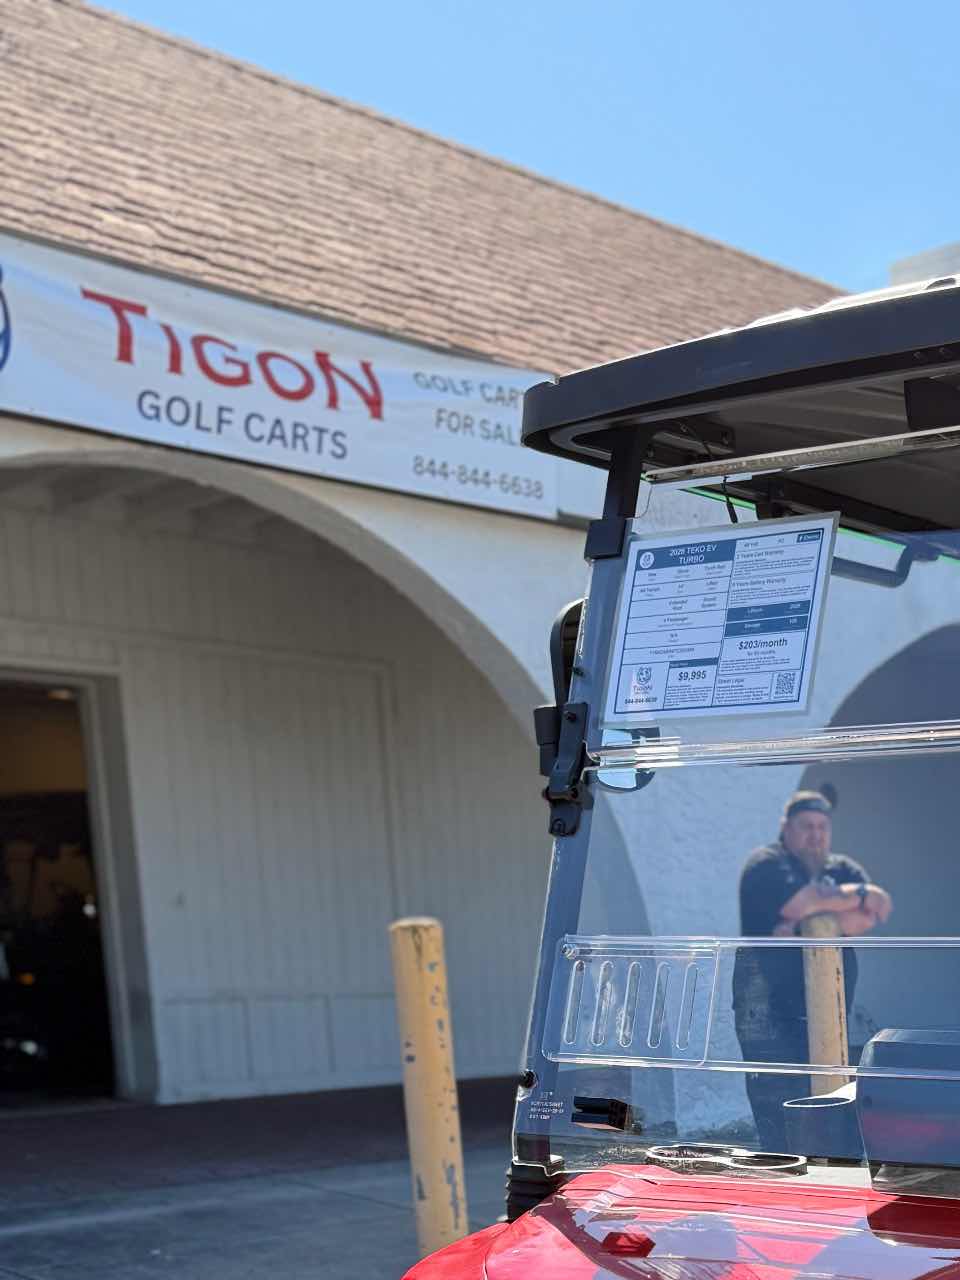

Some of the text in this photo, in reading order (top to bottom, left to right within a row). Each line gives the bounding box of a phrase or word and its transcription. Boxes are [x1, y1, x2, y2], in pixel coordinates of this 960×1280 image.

[81, 287, 385, 421] TIGON
[413, 371, 524, 409] GOLF CAR
[137, 389, 349, 461] GOLF CARTS
[435, 408, 521, 447] FOR SAL
[413, 454, 544, 500] 844-844-6638
[679, 554, 705, 565] TURBO
[706, 544, 718, 552] EV
[738, 638, 787, 651] $203/month
[678, 670, 707, 681] $9,995
